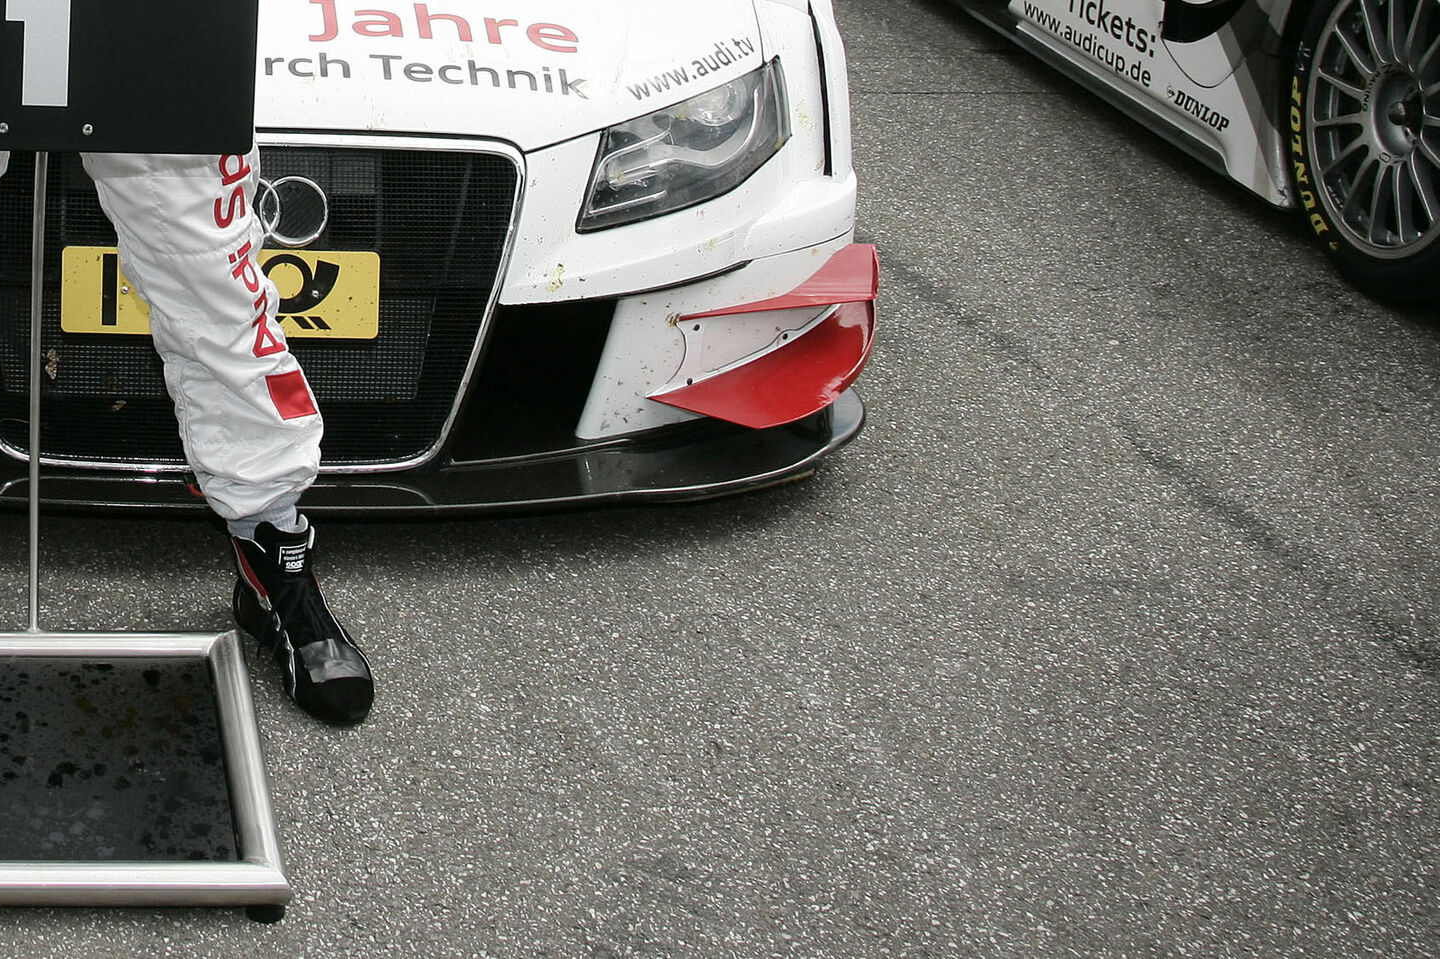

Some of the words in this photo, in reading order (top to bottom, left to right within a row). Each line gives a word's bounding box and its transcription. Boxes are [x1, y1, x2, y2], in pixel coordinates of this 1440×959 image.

[370, 54, 589, 101] Technik
[627, 34, 755, 101] www.audi.tv
[1173, 87, 1230, 133] DUNLOP
[1290, 76, 1328, 237] DUNLOP
